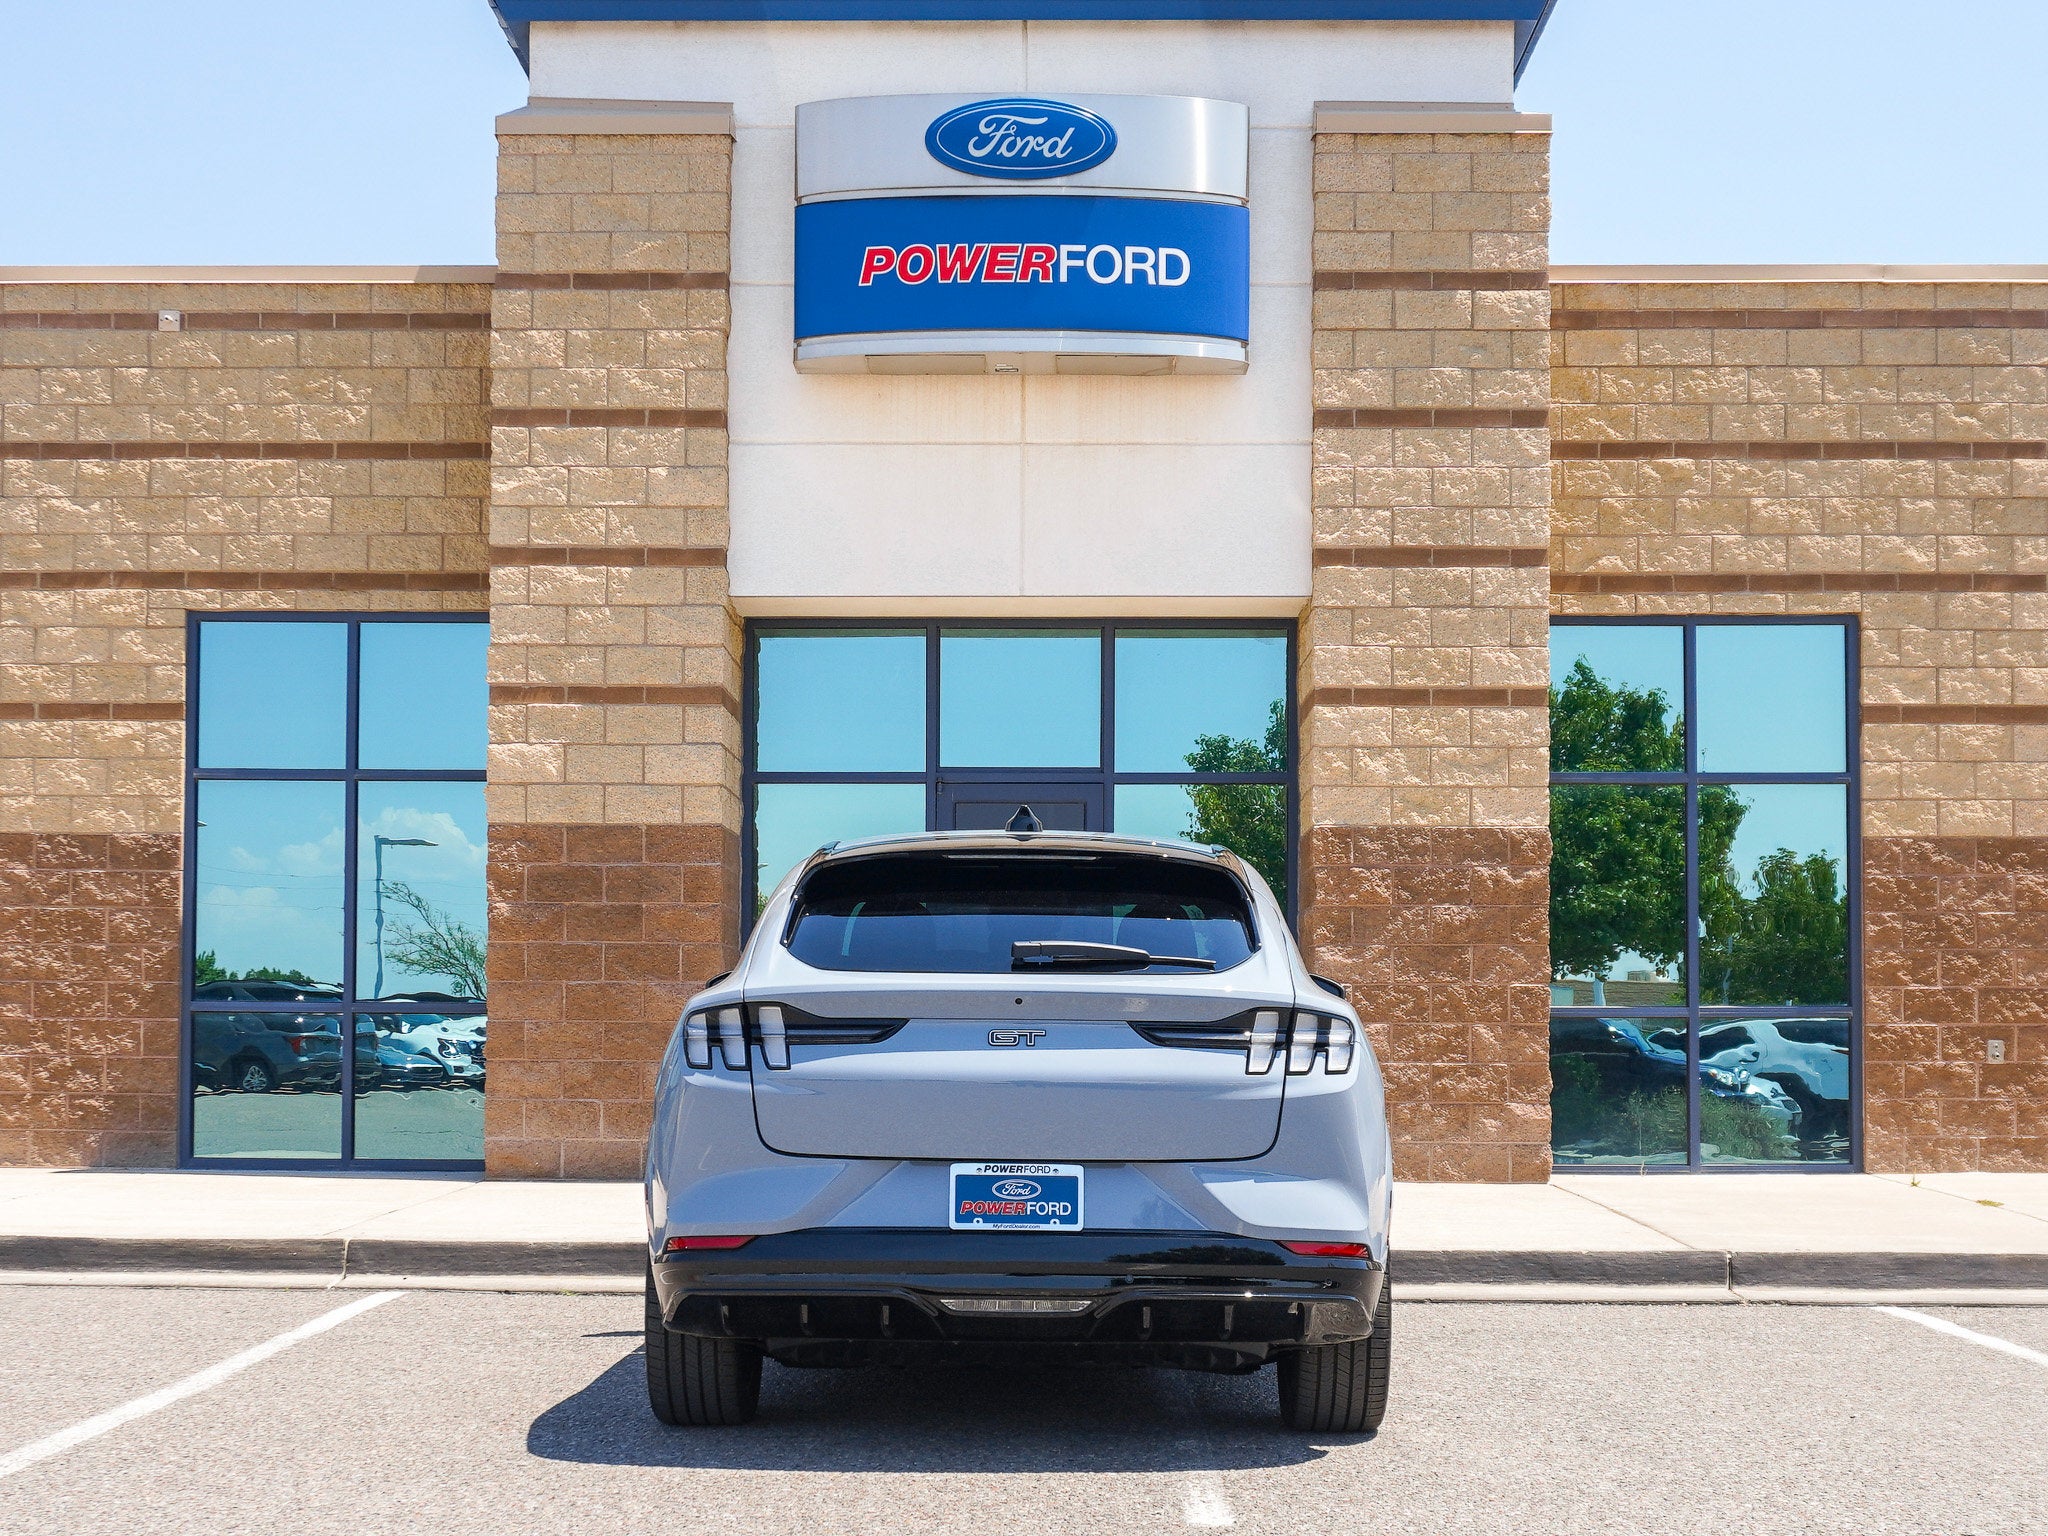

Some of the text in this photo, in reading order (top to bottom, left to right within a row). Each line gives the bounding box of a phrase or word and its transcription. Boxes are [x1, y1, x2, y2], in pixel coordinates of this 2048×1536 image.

[967, 114, 1075, 160] Ford
[858, 243, 1191, 288] POWERFORD
[988, 1029, 1046, 1046] GT
[984, 1164, 1051, 1174] POWERFORD
[1001, 1183, 1031, 1195] Ford
[960, 1200, 1072, 1216] POWERFORD
